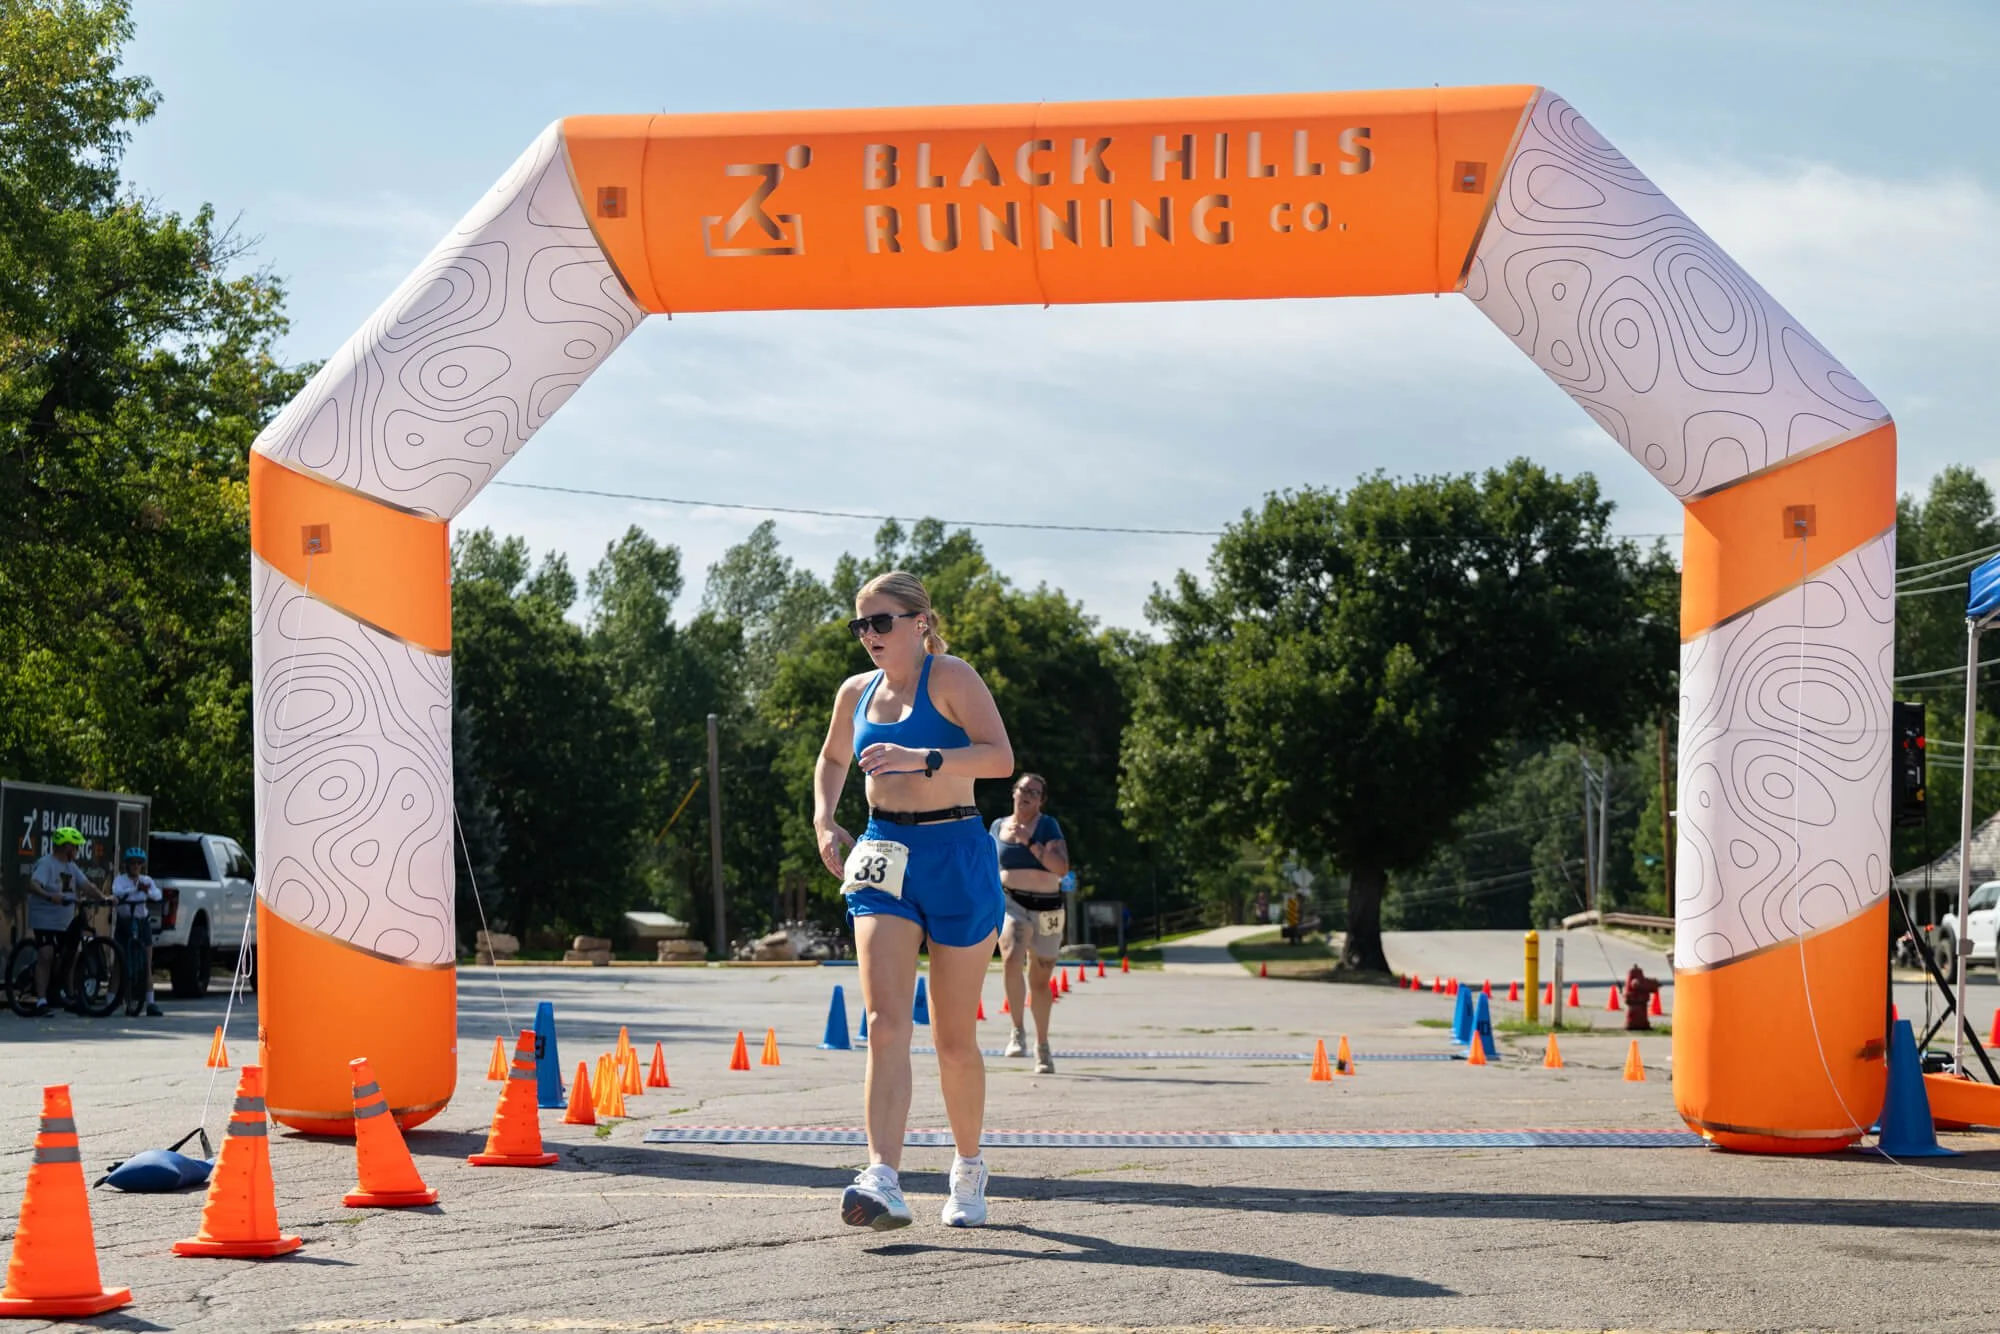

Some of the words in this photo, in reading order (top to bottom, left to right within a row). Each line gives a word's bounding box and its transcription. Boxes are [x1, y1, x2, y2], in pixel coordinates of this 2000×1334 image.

[863, 136, 1117, 190] BLACK
[1150, 126, 1376, 182] HILLS
[864, 194, 1235, 254] RUNNING
[42, 810, 77, 832] BLACK
[81, 813, 110, 837] HILLS
[854, 855, 888, 884] 33
[1047, 915, 1059, 930] 34
